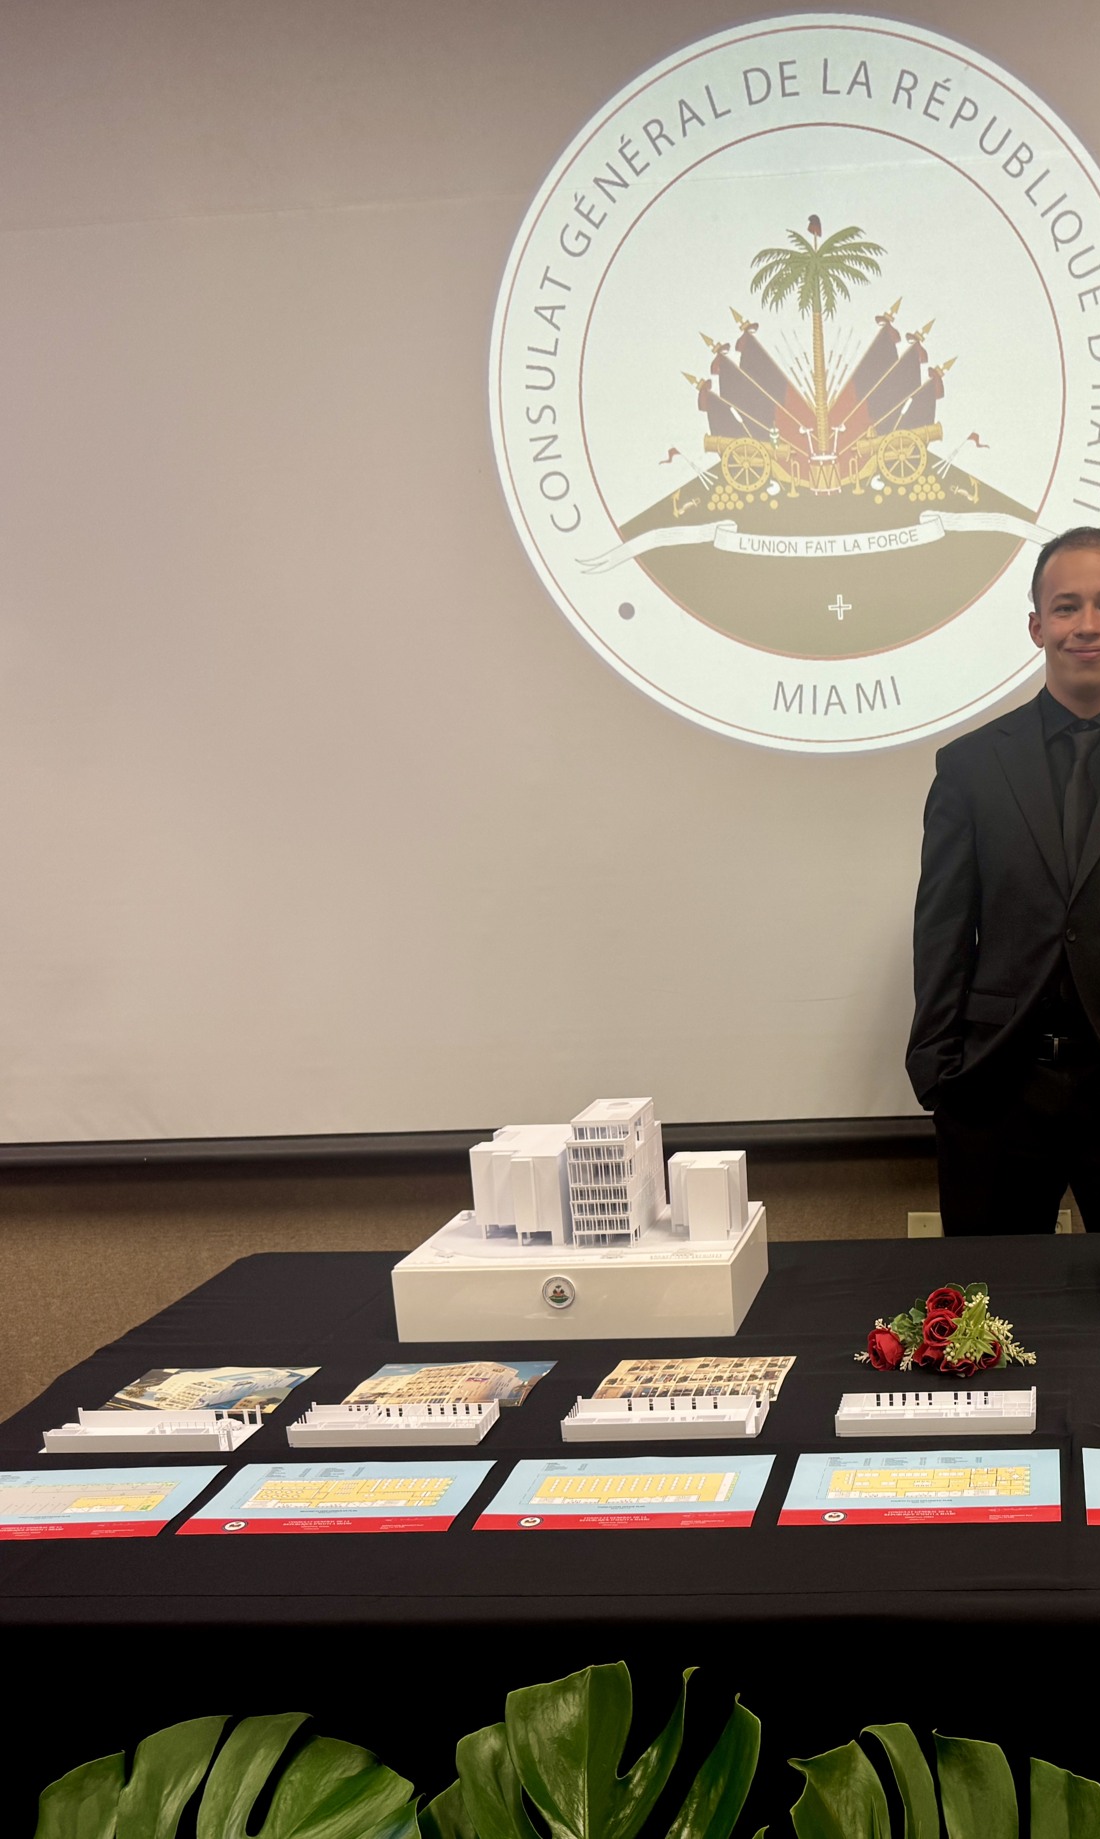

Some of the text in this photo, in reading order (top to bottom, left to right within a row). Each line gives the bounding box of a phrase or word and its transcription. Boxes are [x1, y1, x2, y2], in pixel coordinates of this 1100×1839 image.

[524, 264, 582, 534] CONSULAT
[560, 85, 732, 258] GÉNÉRAL
[742, 60, 801, 107] DE
[821, 57, 873, 100] LA
[738, 528, 919, 554] L'UNION FAIT LA FORCE
[773, 675, 901, 716] MIAMI
